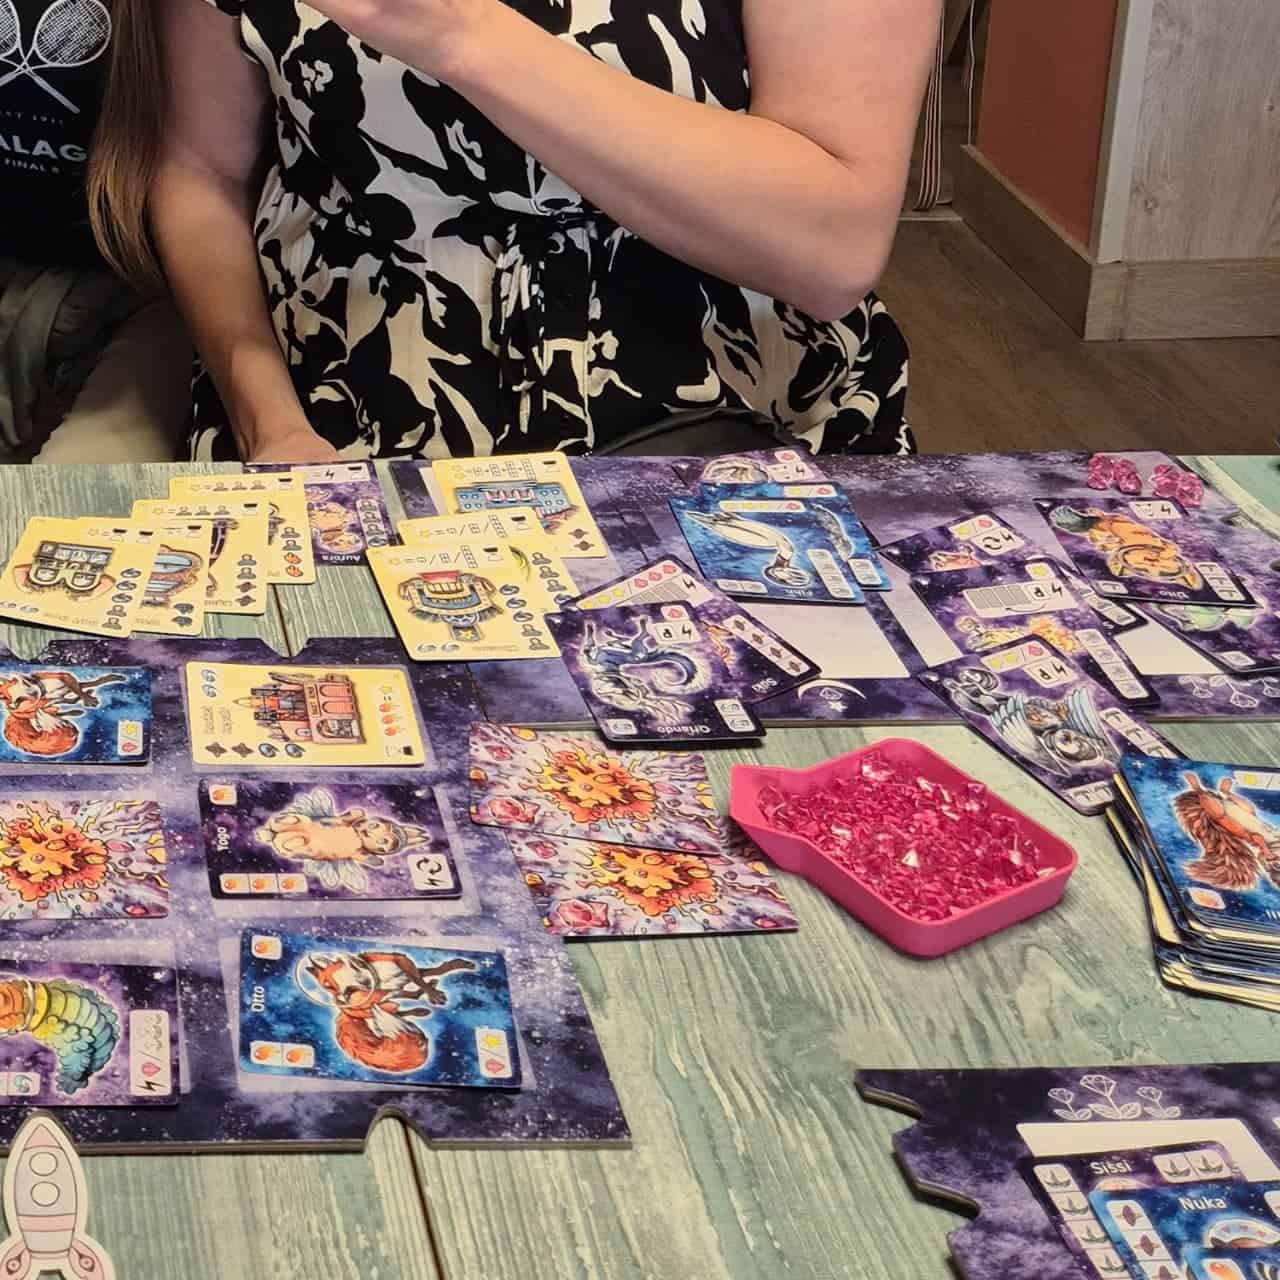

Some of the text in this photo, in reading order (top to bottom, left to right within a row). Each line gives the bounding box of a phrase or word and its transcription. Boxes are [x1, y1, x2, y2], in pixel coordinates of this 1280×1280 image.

[656, 723, 712, 736] Orlando
[216, 826, 231, 852] Yogo
[251, 985, 266, 1012] Otto
[1089, 1159, 1134, 1175] Sissi
[1177, 1195, 1228, 1212] Nuka
